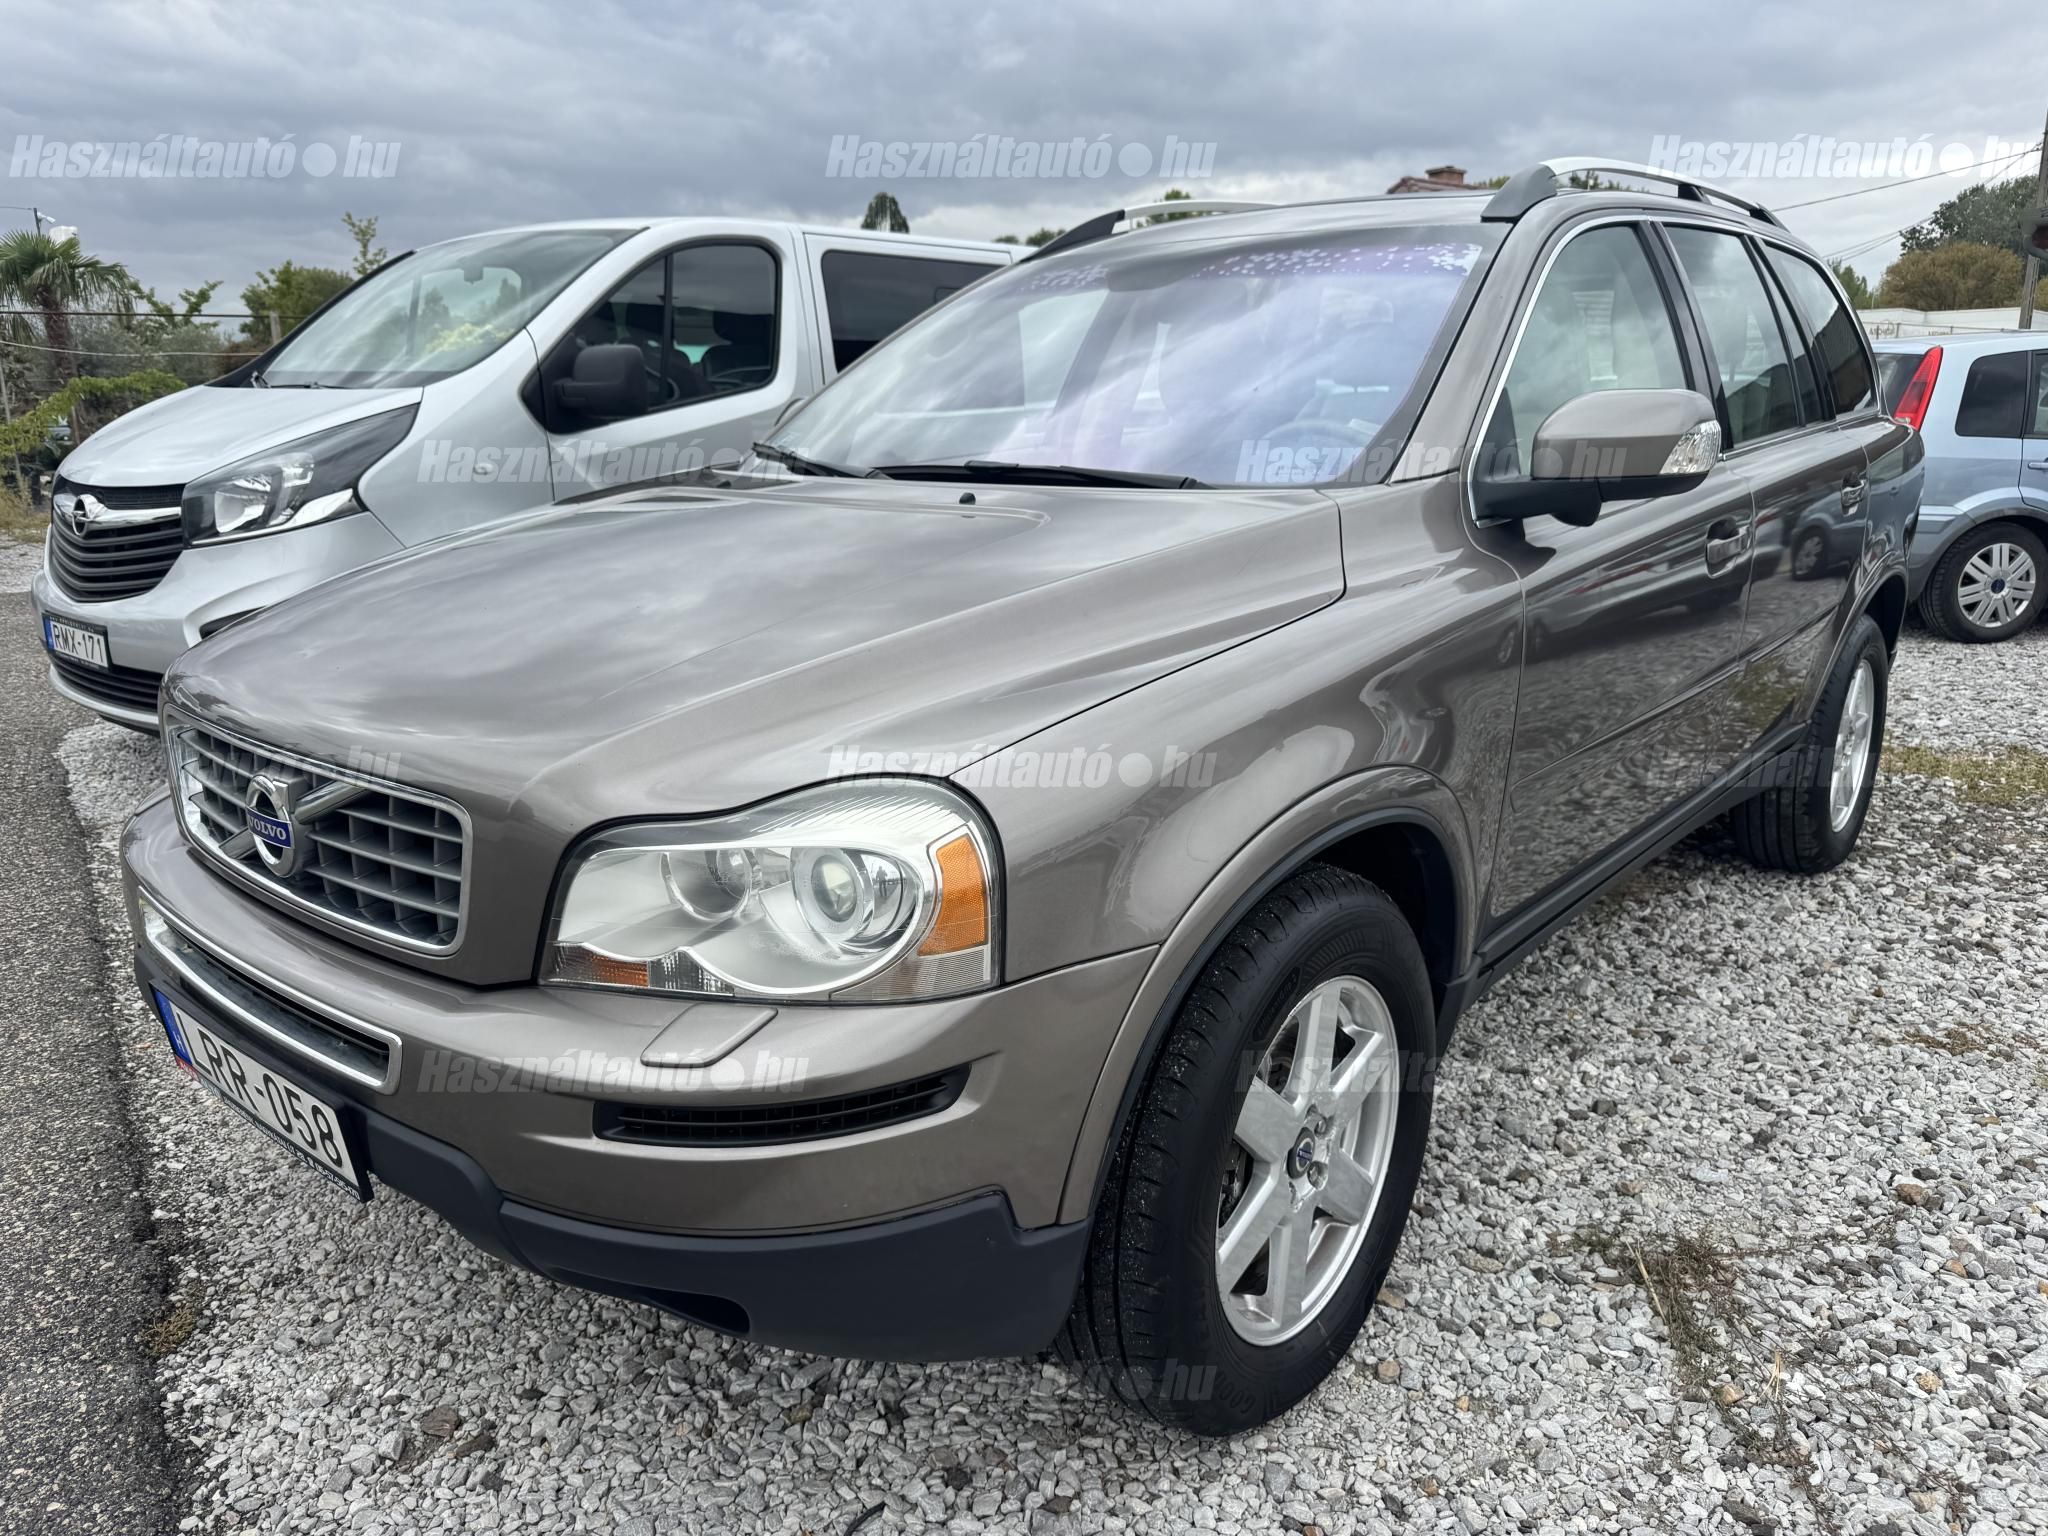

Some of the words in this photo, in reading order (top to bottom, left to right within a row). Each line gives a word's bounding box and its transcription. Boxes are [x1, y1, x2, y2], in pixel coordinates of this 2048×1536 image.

[53, 624, 104, 663] RMX-171
[249, 816, 287, 841] VOLVO
[176, 1010, 343, 1169] LRR-058
